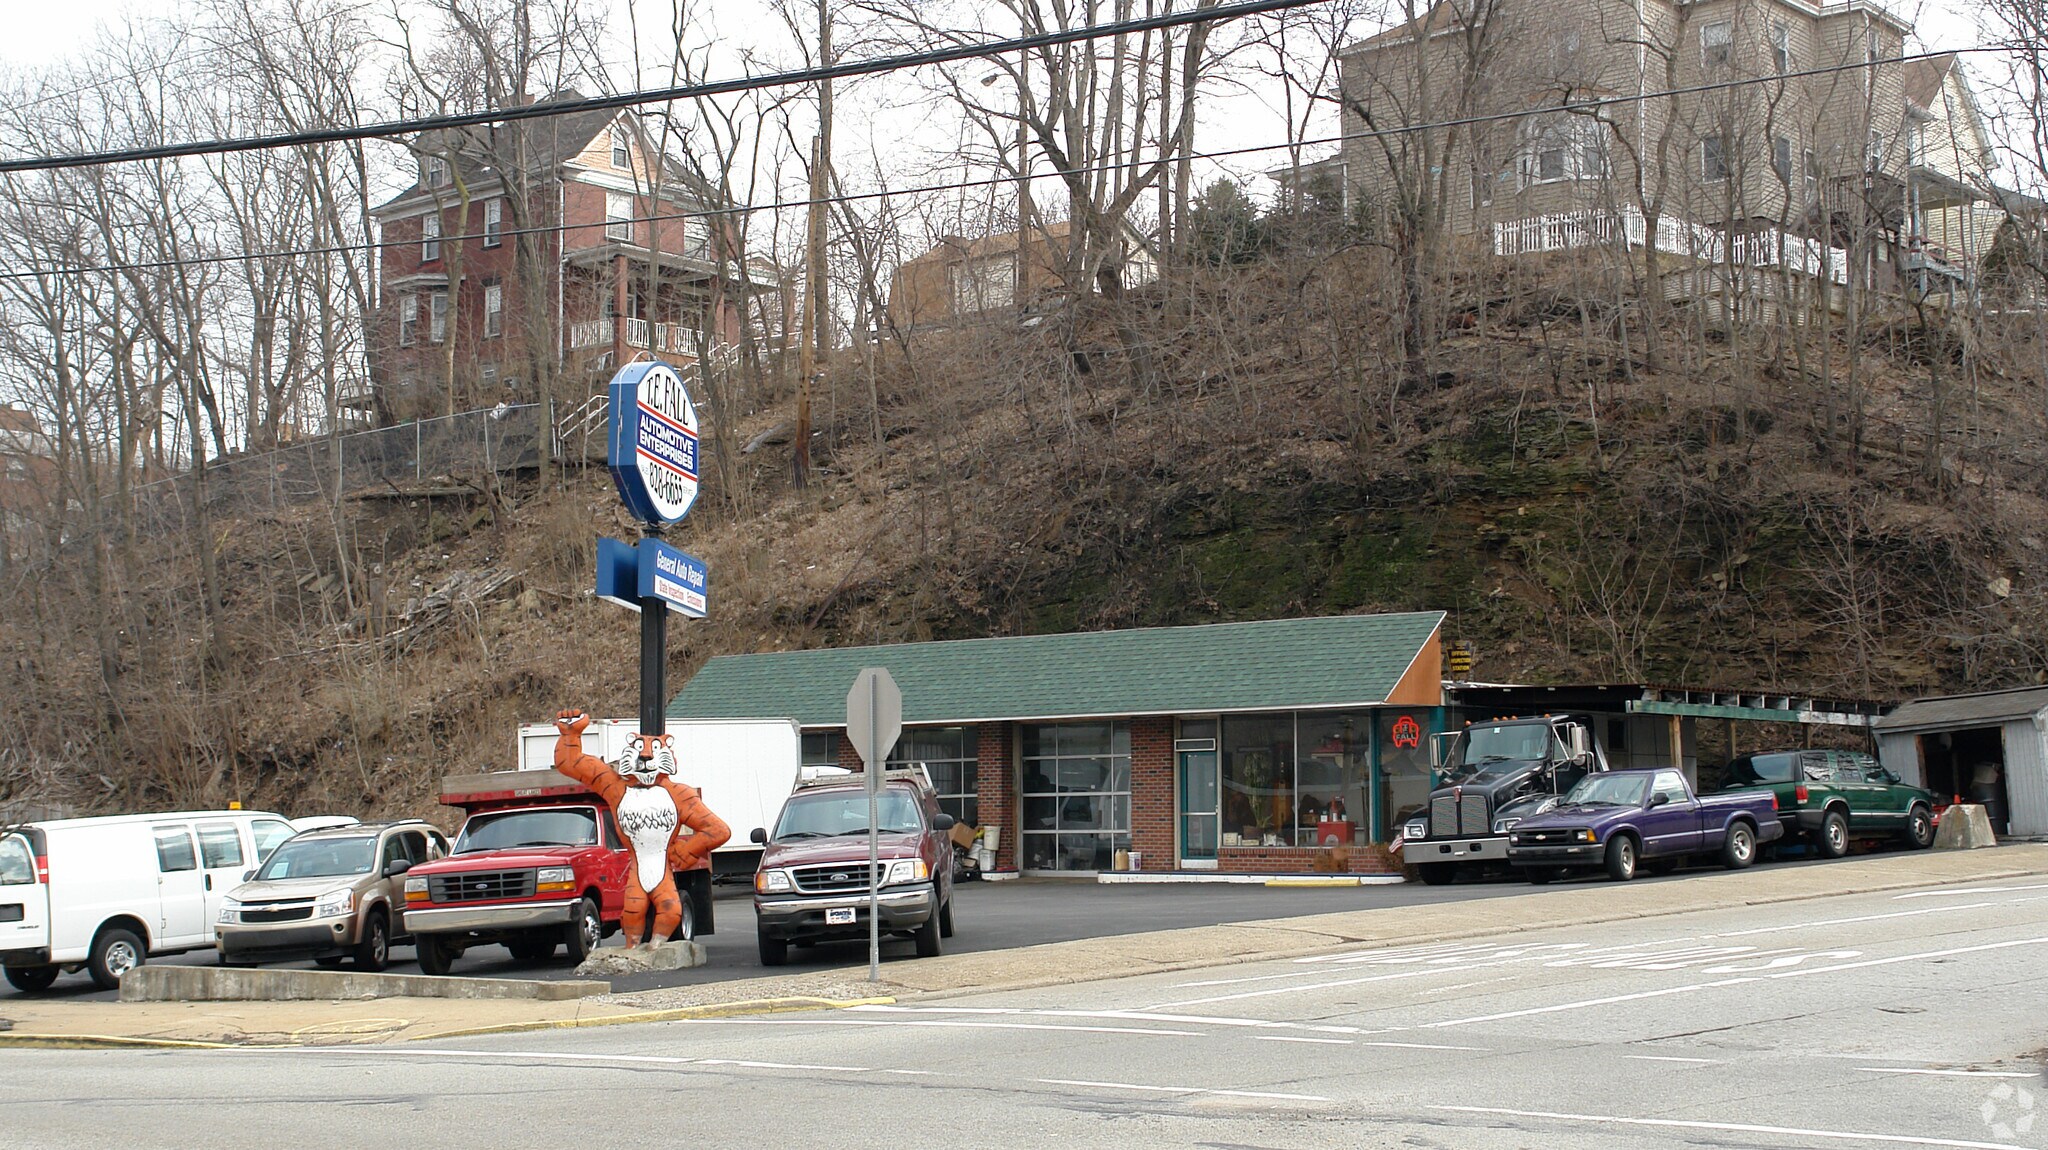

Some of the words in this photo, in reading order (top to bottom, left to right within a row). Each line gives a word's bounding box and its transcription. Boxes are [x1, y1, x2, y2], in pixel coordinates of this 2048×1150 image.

[664, 375, 689, 426] FALL
[640, 414, 693, 455] AUTOMOTIVE
[640, 429, 693, 470] ENTERPRISES
[650, 462, 682, 505] 828-6655
[657, 549, 676, 575] General
[676, 559, 688, 580] Auto
[687, 564, 704, 588] Repair
[1395, 732, 1416, 741] FALL
